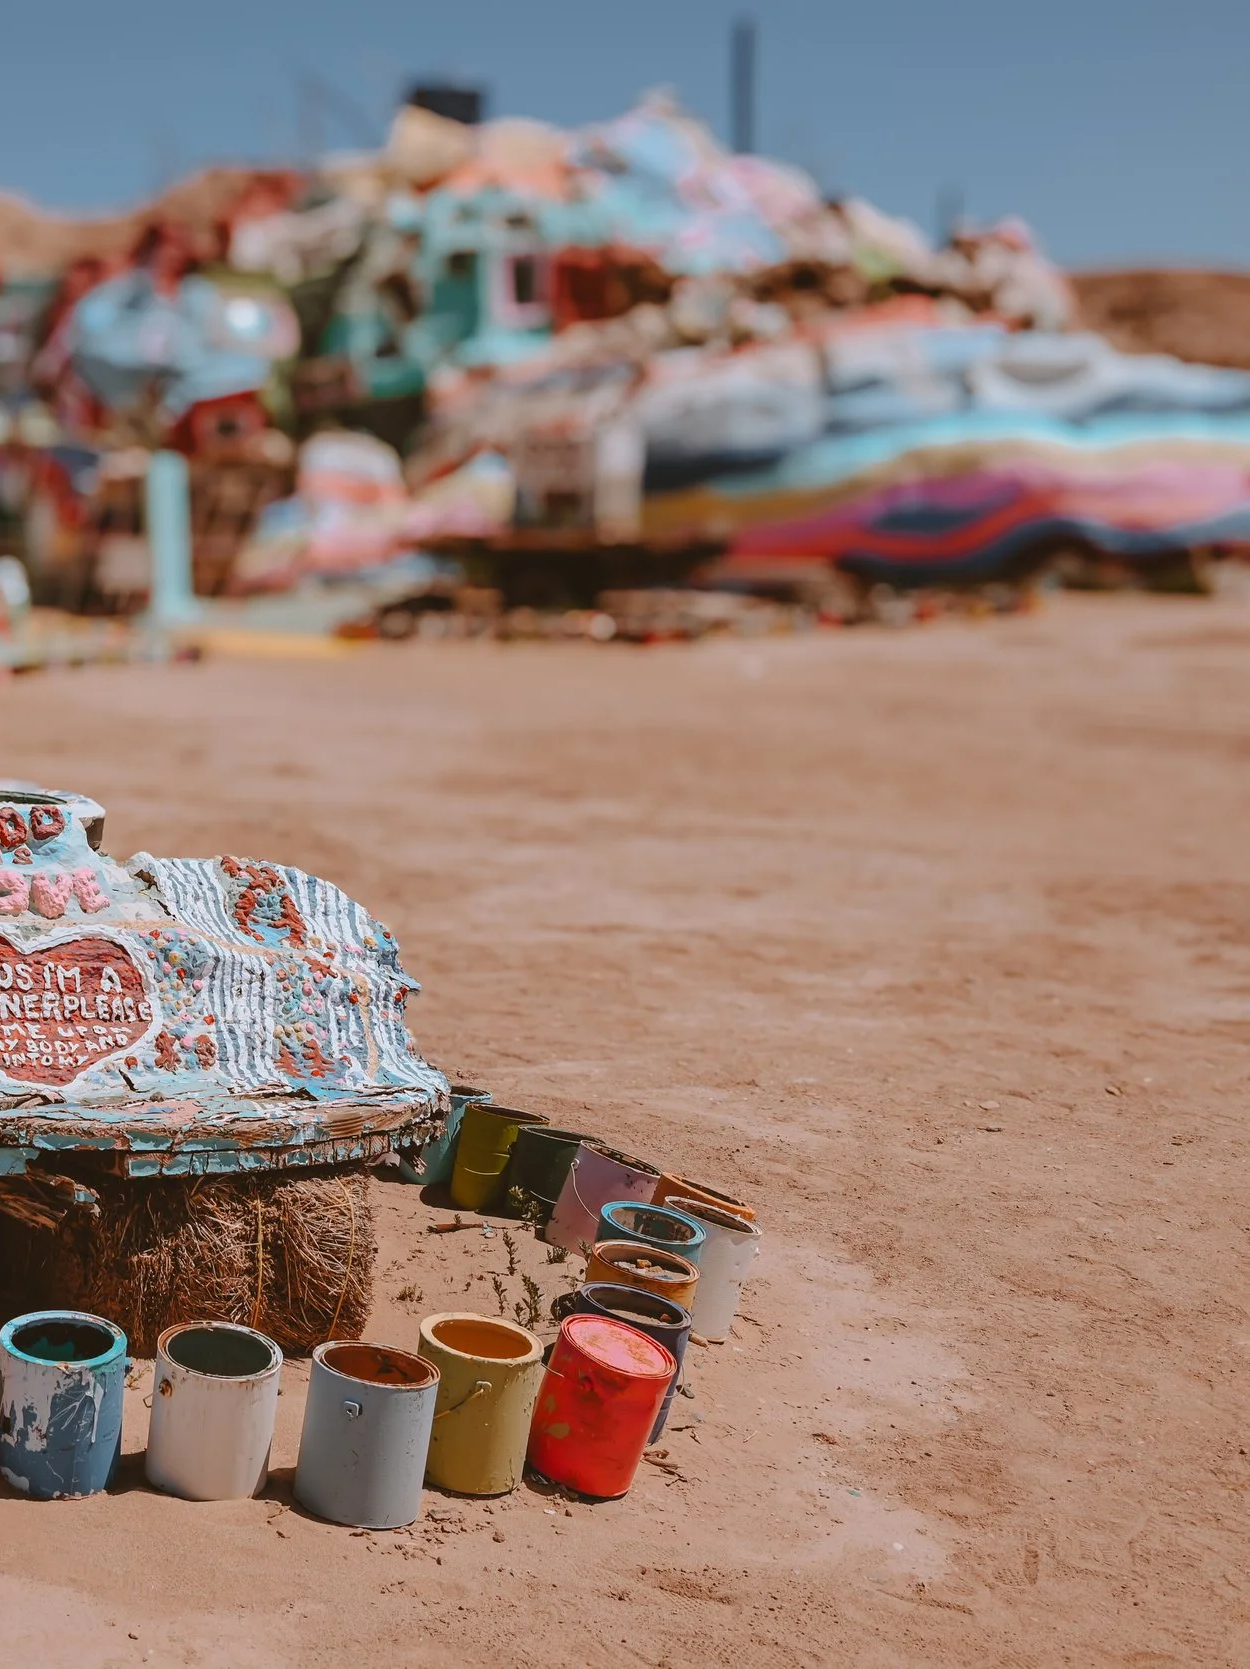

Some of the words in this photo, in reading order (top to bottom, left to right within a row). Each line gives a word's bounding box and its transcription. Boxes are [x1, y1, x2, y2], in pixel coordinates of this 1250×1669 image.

[100, 965, 124, 994] A
[26, 1039, 81, 1055] BODY
[84, 1033, 130, 1053] AND
